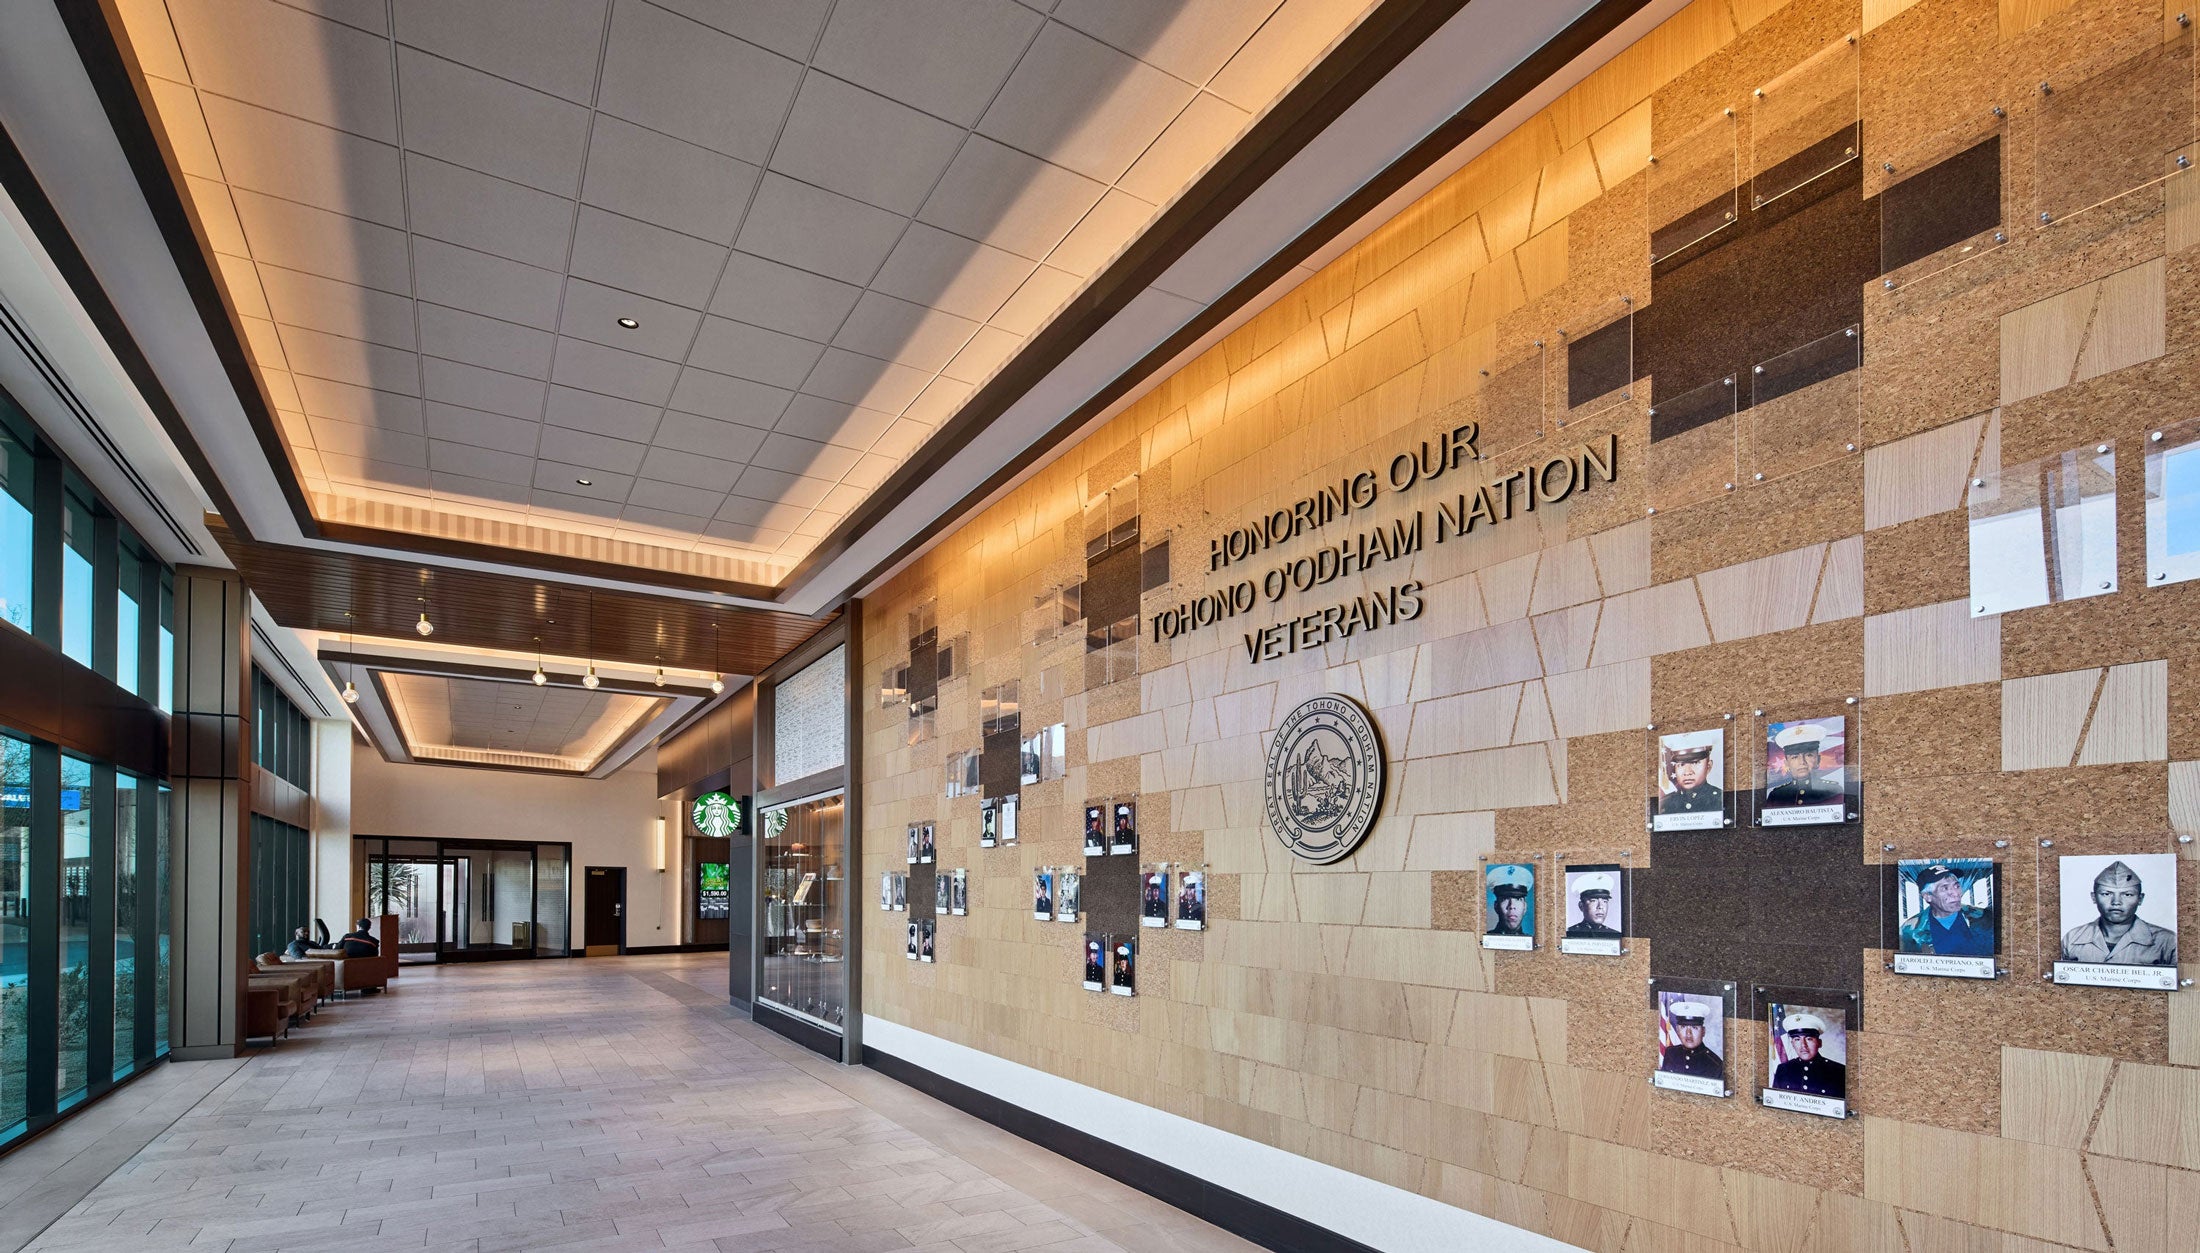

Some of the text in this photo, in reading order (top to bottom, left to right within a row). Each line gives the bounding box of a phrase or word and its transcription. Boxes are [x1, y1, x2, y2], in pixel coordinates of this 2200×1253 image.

[1149, 433, 1617, 643] TOHONO O'ODHAM NATION
[1210, 420, 1480, 572] HONORING OUR
[1243, 580, 1424, 664] VETERANS
[1266, 701, 1376, 834] GREAT SEAL OF THE TOHONO O'ODHAM NATION
[2092, 967, 2129, 976] CHARLIE
[1799, 1096, 1826, 1106] ANDRES
